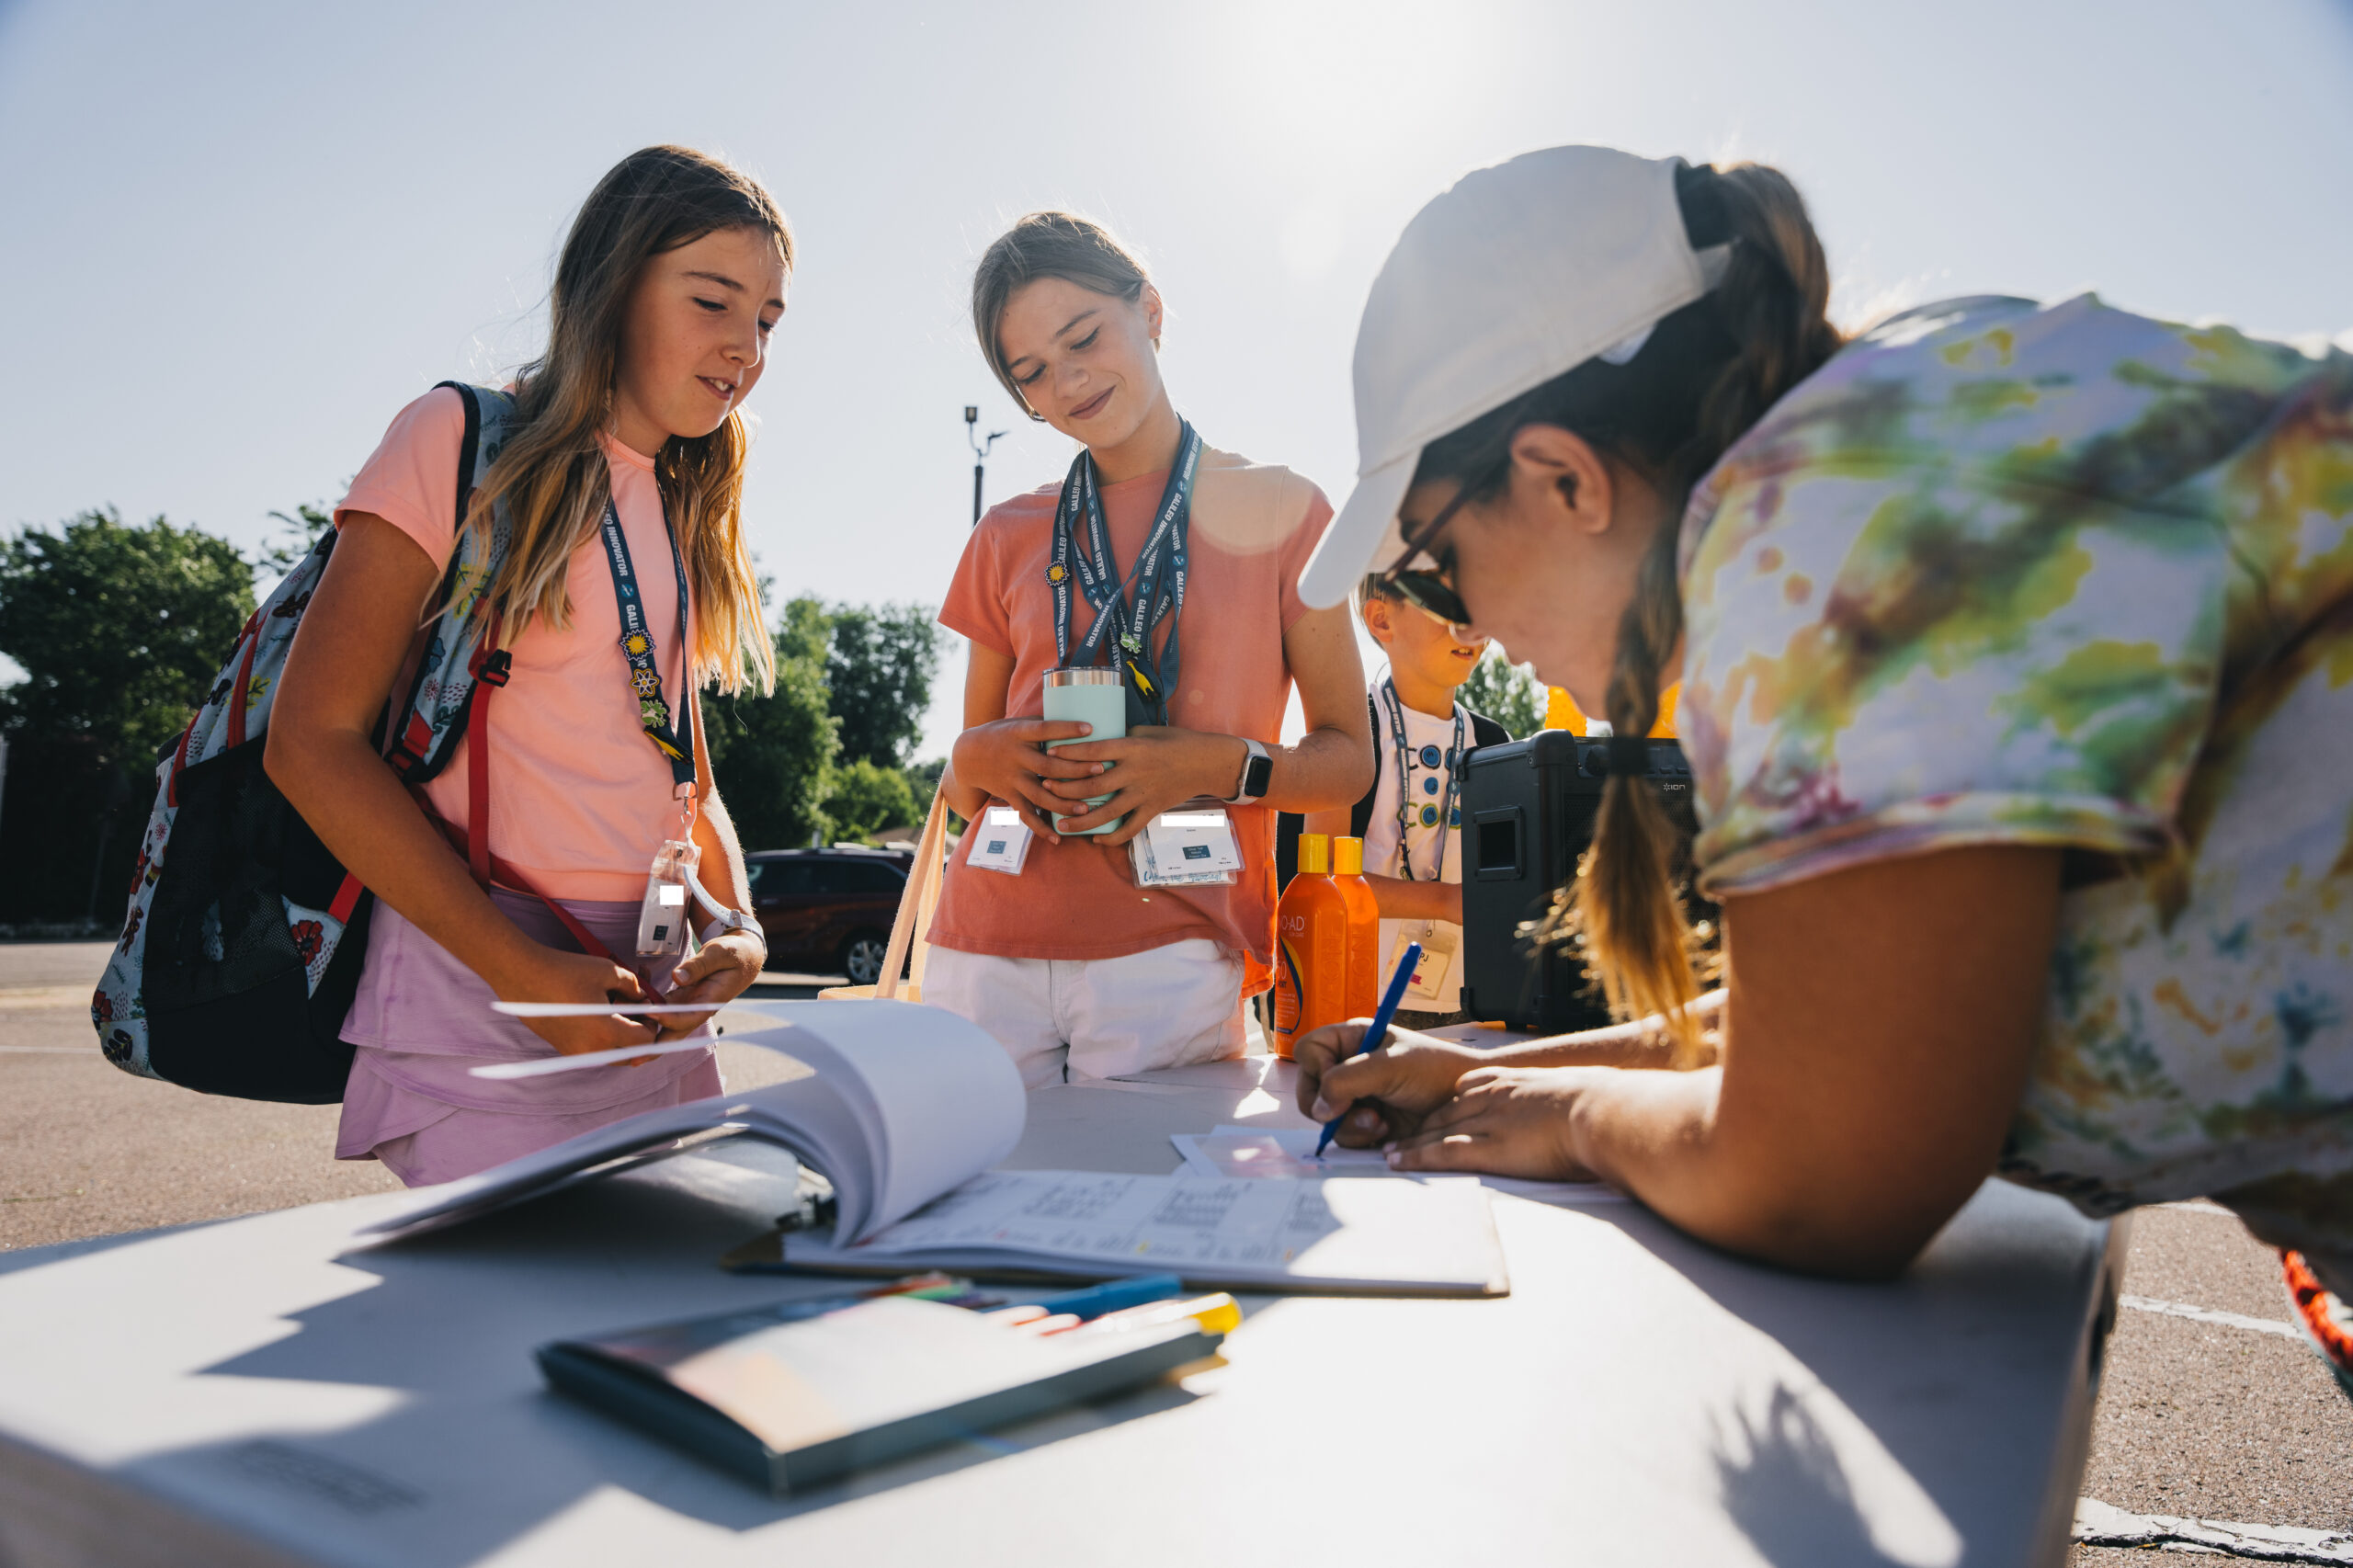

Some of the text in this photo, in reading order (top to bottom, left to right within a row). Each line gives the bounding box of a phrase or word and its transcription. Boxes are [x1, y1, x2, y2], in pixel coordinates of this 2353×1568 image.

[1071, 485, 1080, 512] GALILEO
[1165, 492, 1183, 522] GALILEO
[1058, 537, 1067, 561] ALILEO
[1090, 514, 1107, 581] GALILEO INNOVATOR
[1142, 519, 1168, 560] INNOVATOR
[607, 527, 629, 577] INNOVATOR
[626, 604, 639, 630] GALI
[1078, 560, 1095, 585] GALILEO
[1176, 571, 1185, 607] GALILEO
[1086, 605, 1110, 648] INNOVATOR
[1133, 598, 1147, 632] GALILEO
[1151, 595, 1171, 626] GALILEO
